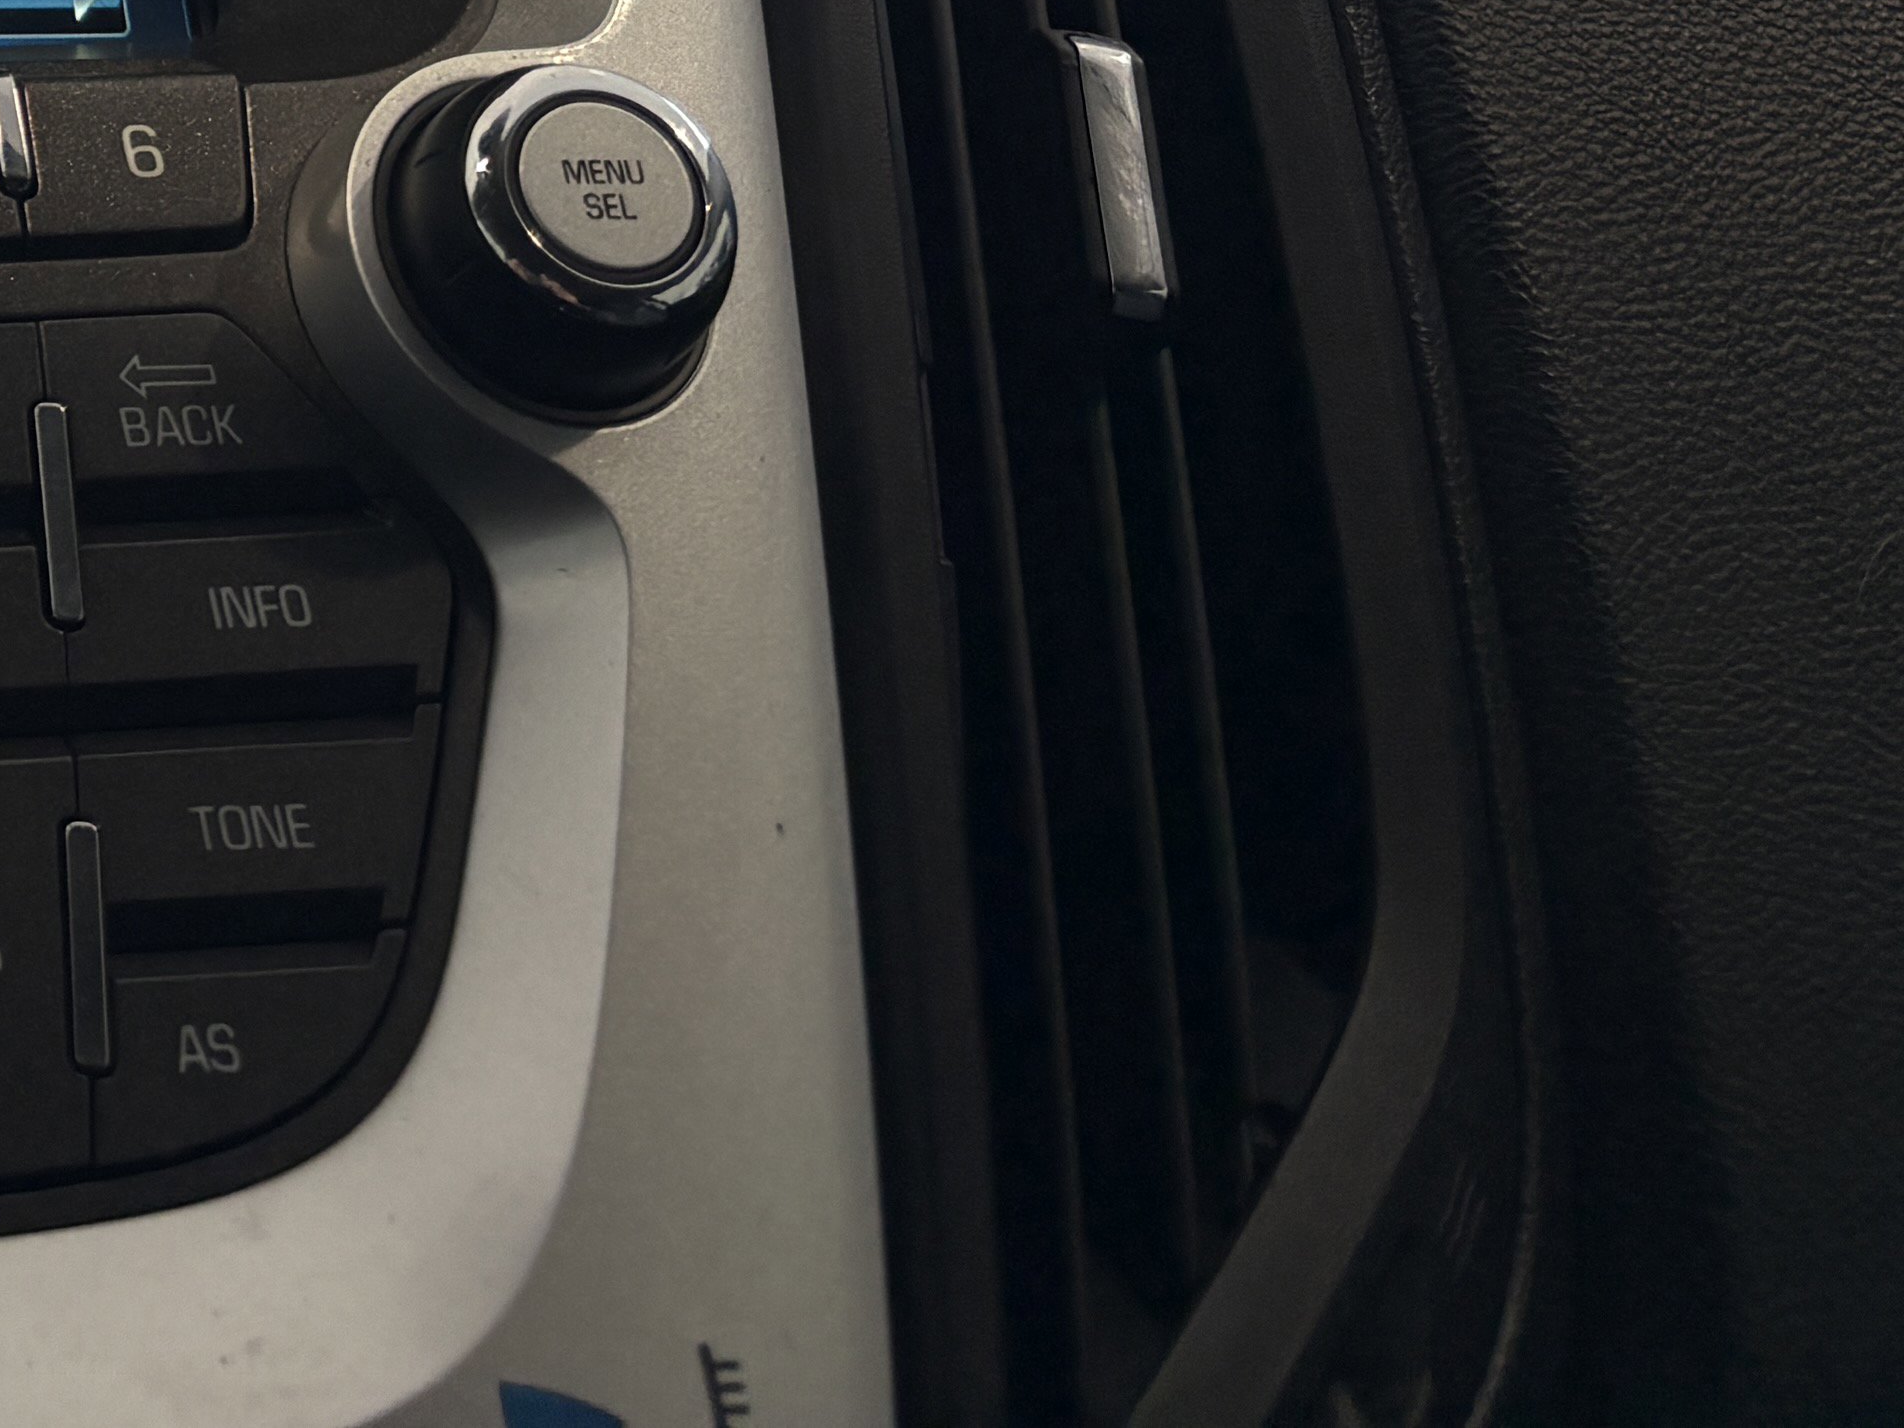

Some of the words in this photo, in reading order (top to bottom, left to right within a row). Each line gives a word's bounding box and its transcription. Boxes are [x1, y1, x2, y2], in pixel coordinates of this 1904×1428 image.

[122, 124, 164, 177] 6
[561, 157, 645, 189] MENU
[583, 191, 638, 223] SEL
[121, 404, 242, 449] BACK
[207, 584, 313, 630] INFO
[188, 803, 315, 850] TONE
[178, 1023, 242, 1073] AS
